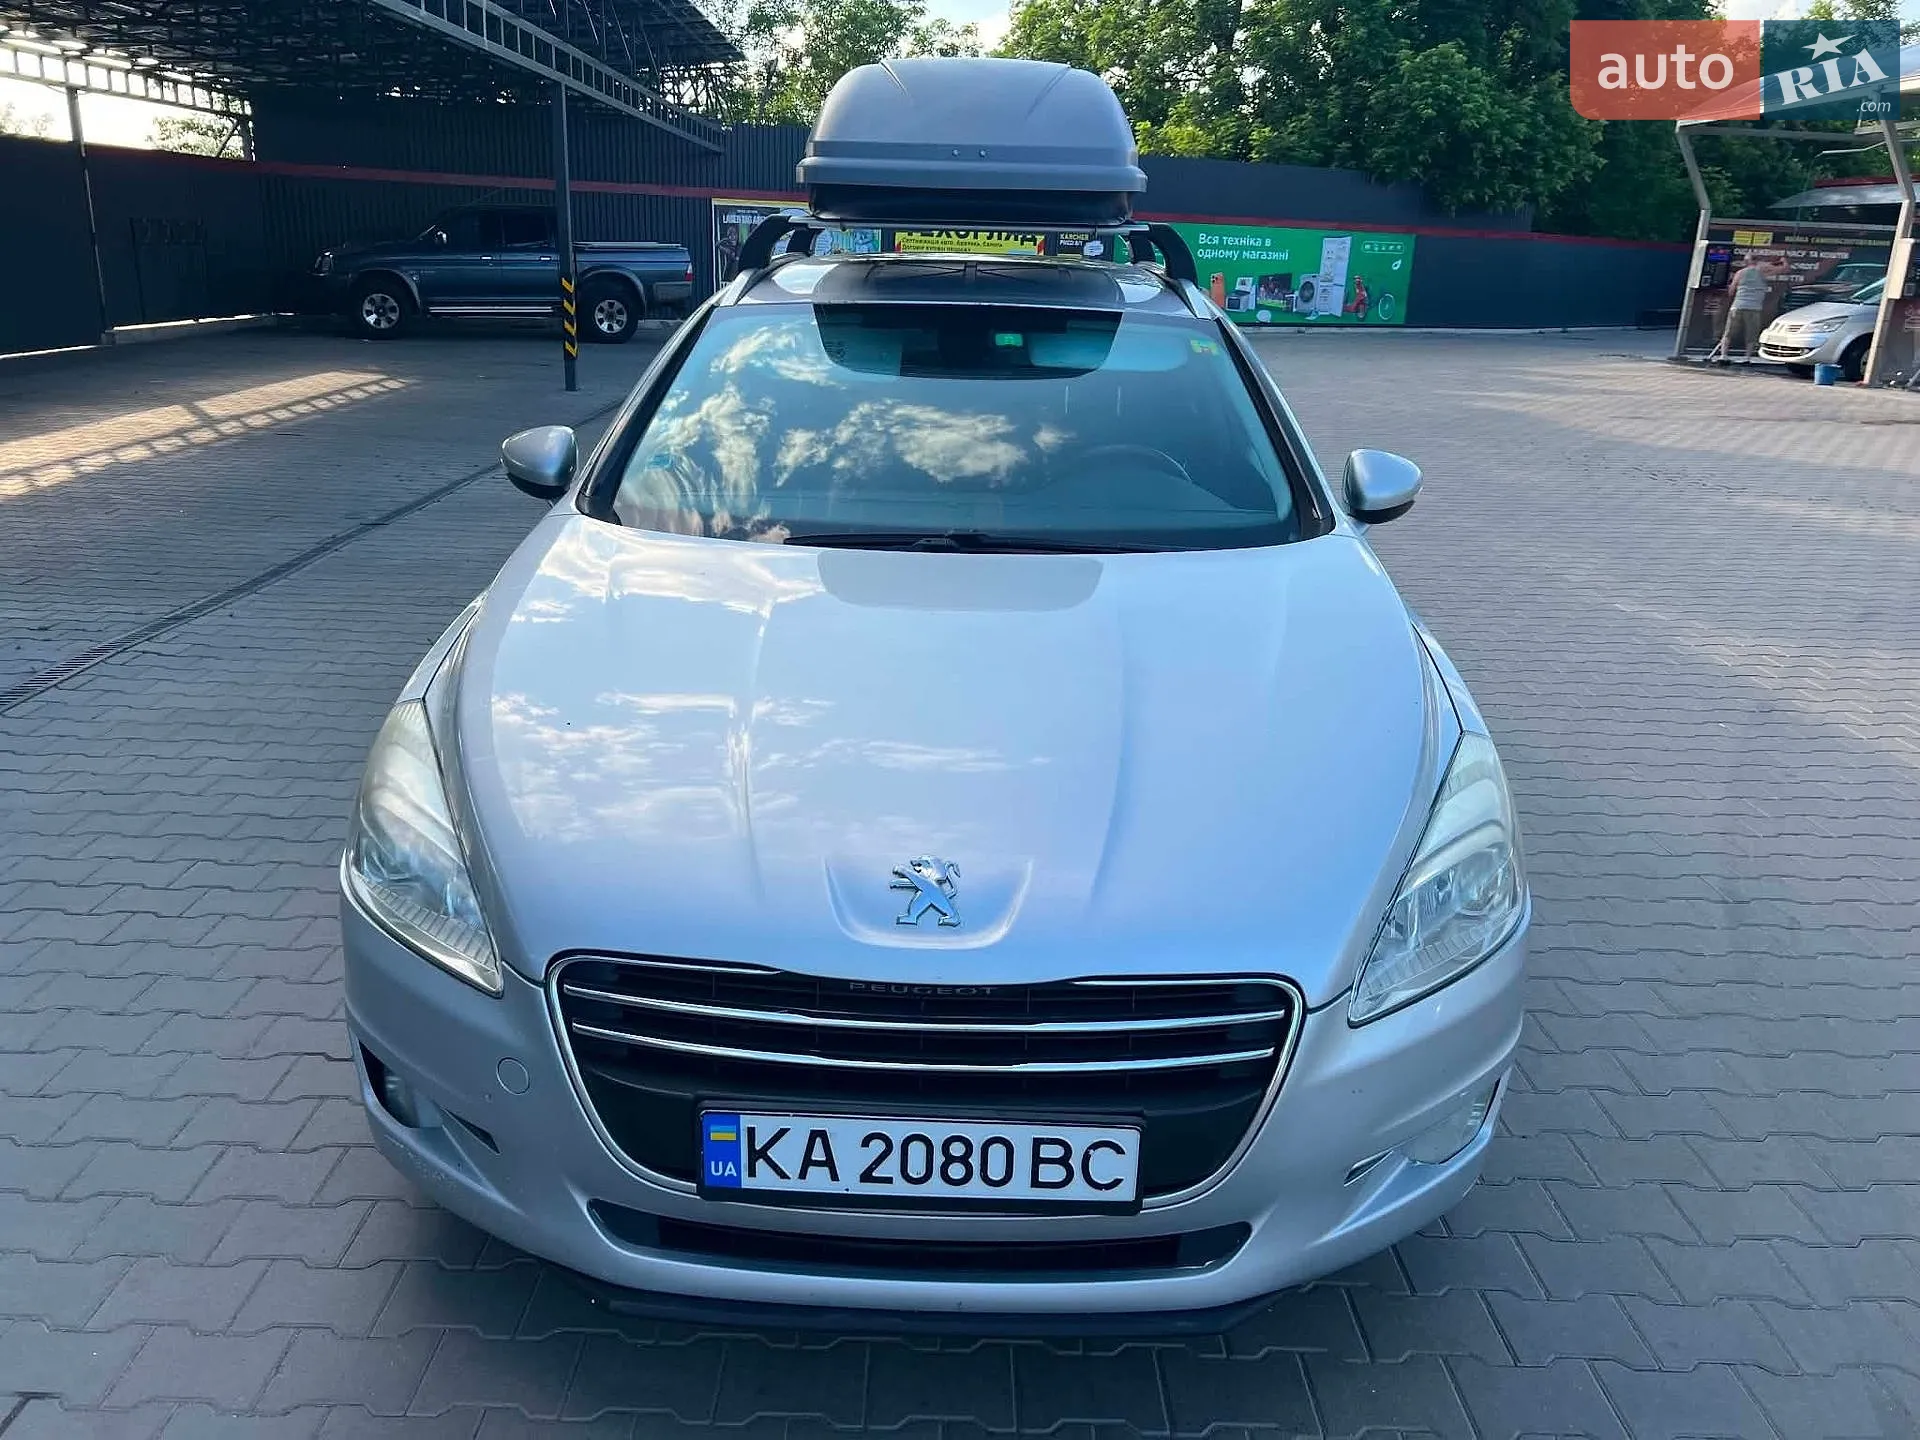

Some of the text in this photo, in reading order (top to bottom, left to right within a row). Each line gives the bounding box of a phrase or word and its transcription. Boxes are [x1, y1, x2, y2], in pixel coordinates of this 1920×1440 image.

[1199, 233, 1272, 247] Вся техніка в
[1197, 248, 1289, 261] одному магазині
[849, 981, 998, 996] PEUGEOT
[745, 1125, 1127, 1192] KA 2080 BC
[710, 1160, 738, 1178] UA
